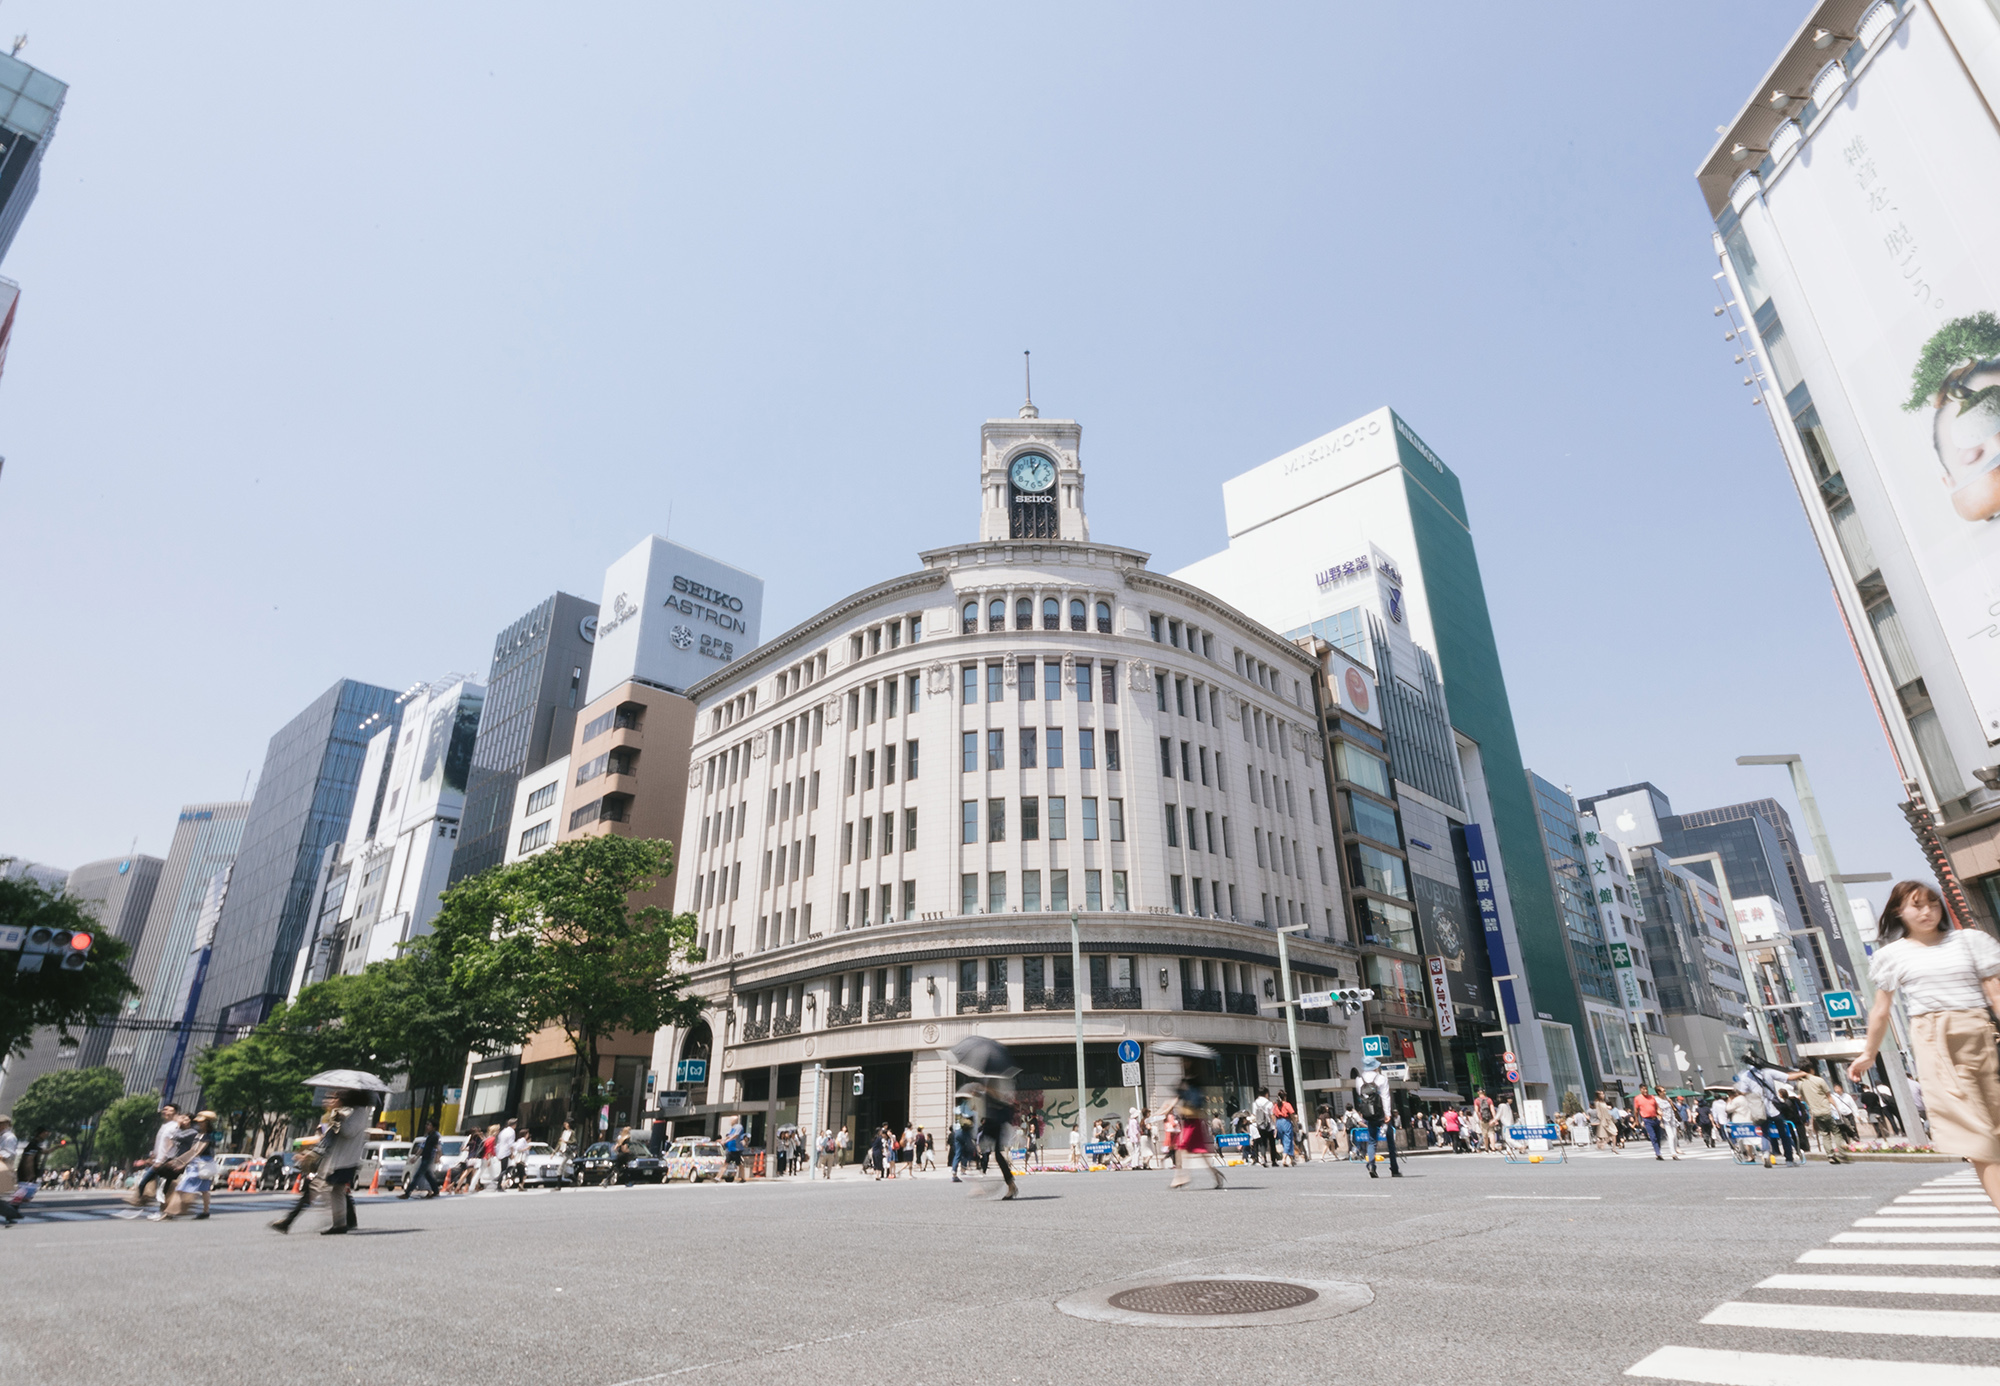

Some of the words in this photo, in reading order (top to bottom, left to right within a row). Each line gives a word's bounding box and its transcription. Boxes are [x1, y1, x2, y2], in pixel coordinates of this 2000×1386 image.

[1283, 420, 1382, 476] MIKIMOTO
[1396, 418, 1444, 474] MIKIMOTO
[1015, 495, 1053, 503] SEIKO
[1315, 554, 1369, 587] 山野楽器
[672, 574, 744, 613] SEIKO
[663, 594, 746, 634] ASTRON
[698, 645, 733, 662] SOLAR
[700, 633, 734, 655] GPS
[1584, 831, 1614, 904] 教文館
[1414, 876, 1462, 909] HUBLOT
[1472, 859, 1499, 932] 山野楽器
[1612, 946, 1629, 965] 本
[1434, 977, 1452, 1033] キムラヤのパン
